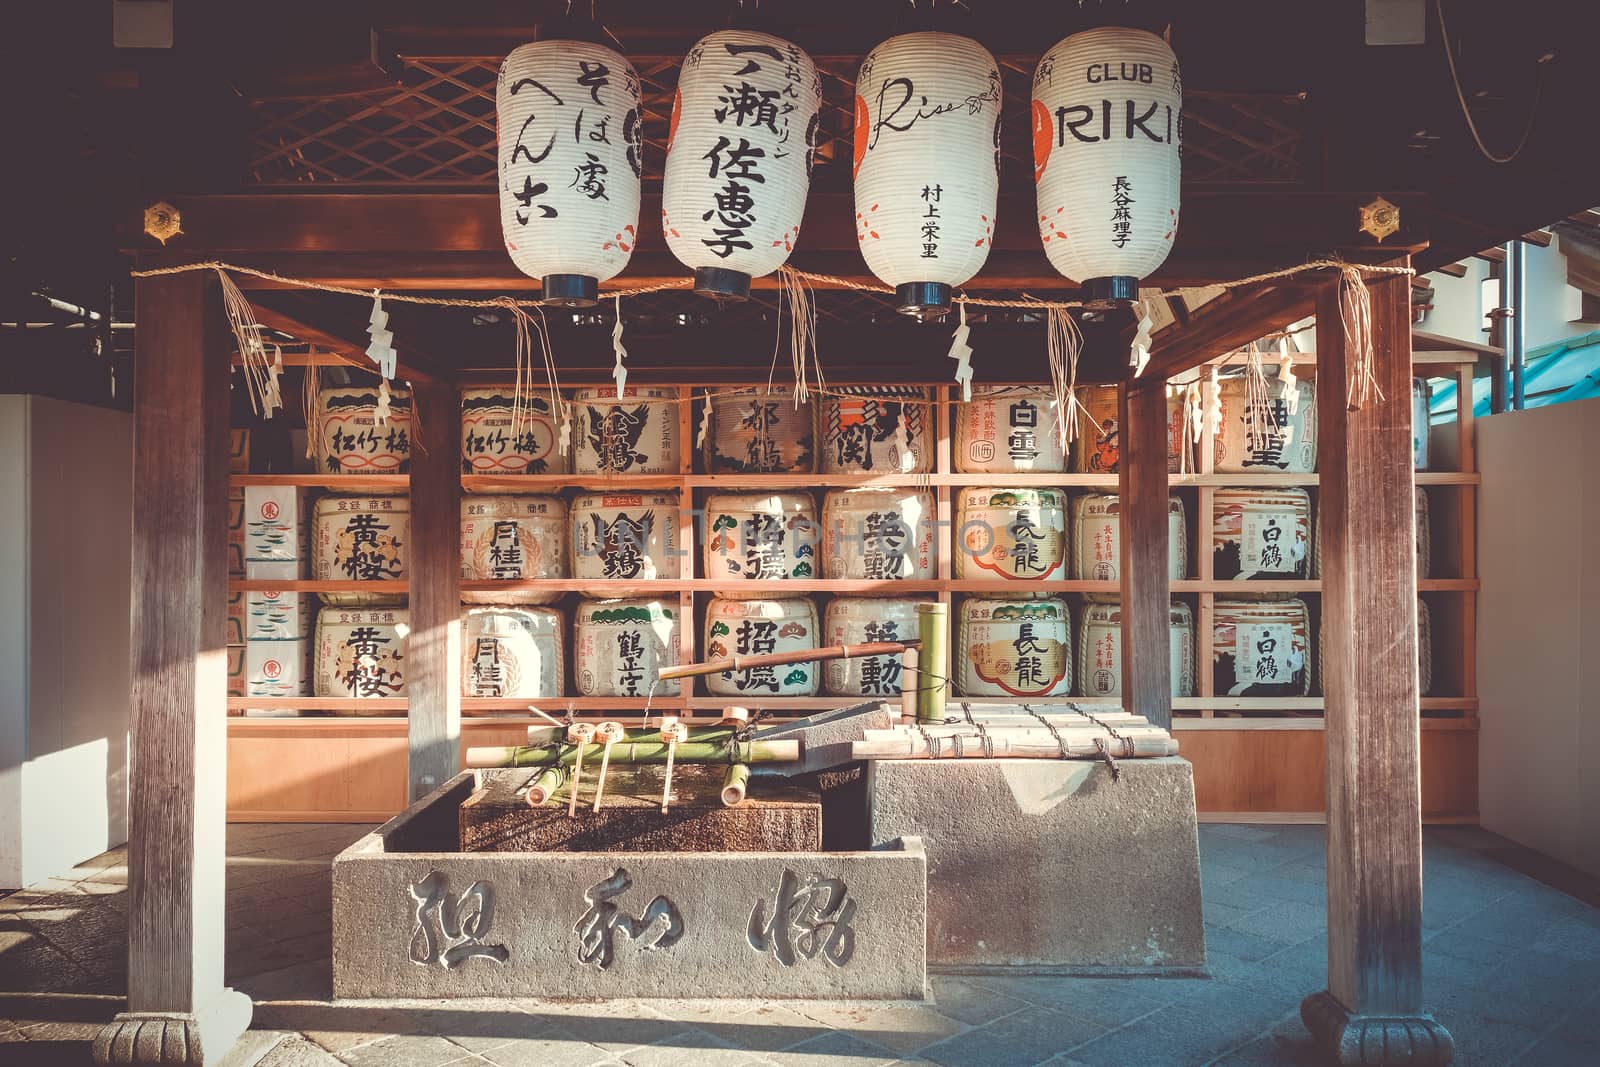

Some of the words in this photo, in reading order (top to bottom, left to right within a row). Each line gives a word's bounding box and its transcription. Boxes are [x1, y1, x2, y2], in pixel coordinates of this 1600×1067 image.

[1086, 62, 1153, 84] CLUB
[869, 78, 965, 150] Rise
[1055, 99, 1172, 147] RIKI
[920, 184, 943, 259] 村上栄里
[1110, 176, 1136, 248] 長谷麻理子
[332, 426, 410, 455] 松竹梅
[466, 428, 540, 456] 松竹梅
[1261, 519, 1283, 568] 白鶴
[1012, 622, 1050, 687] 長龍
[1256, 630, 1278, 680] 白鶴
